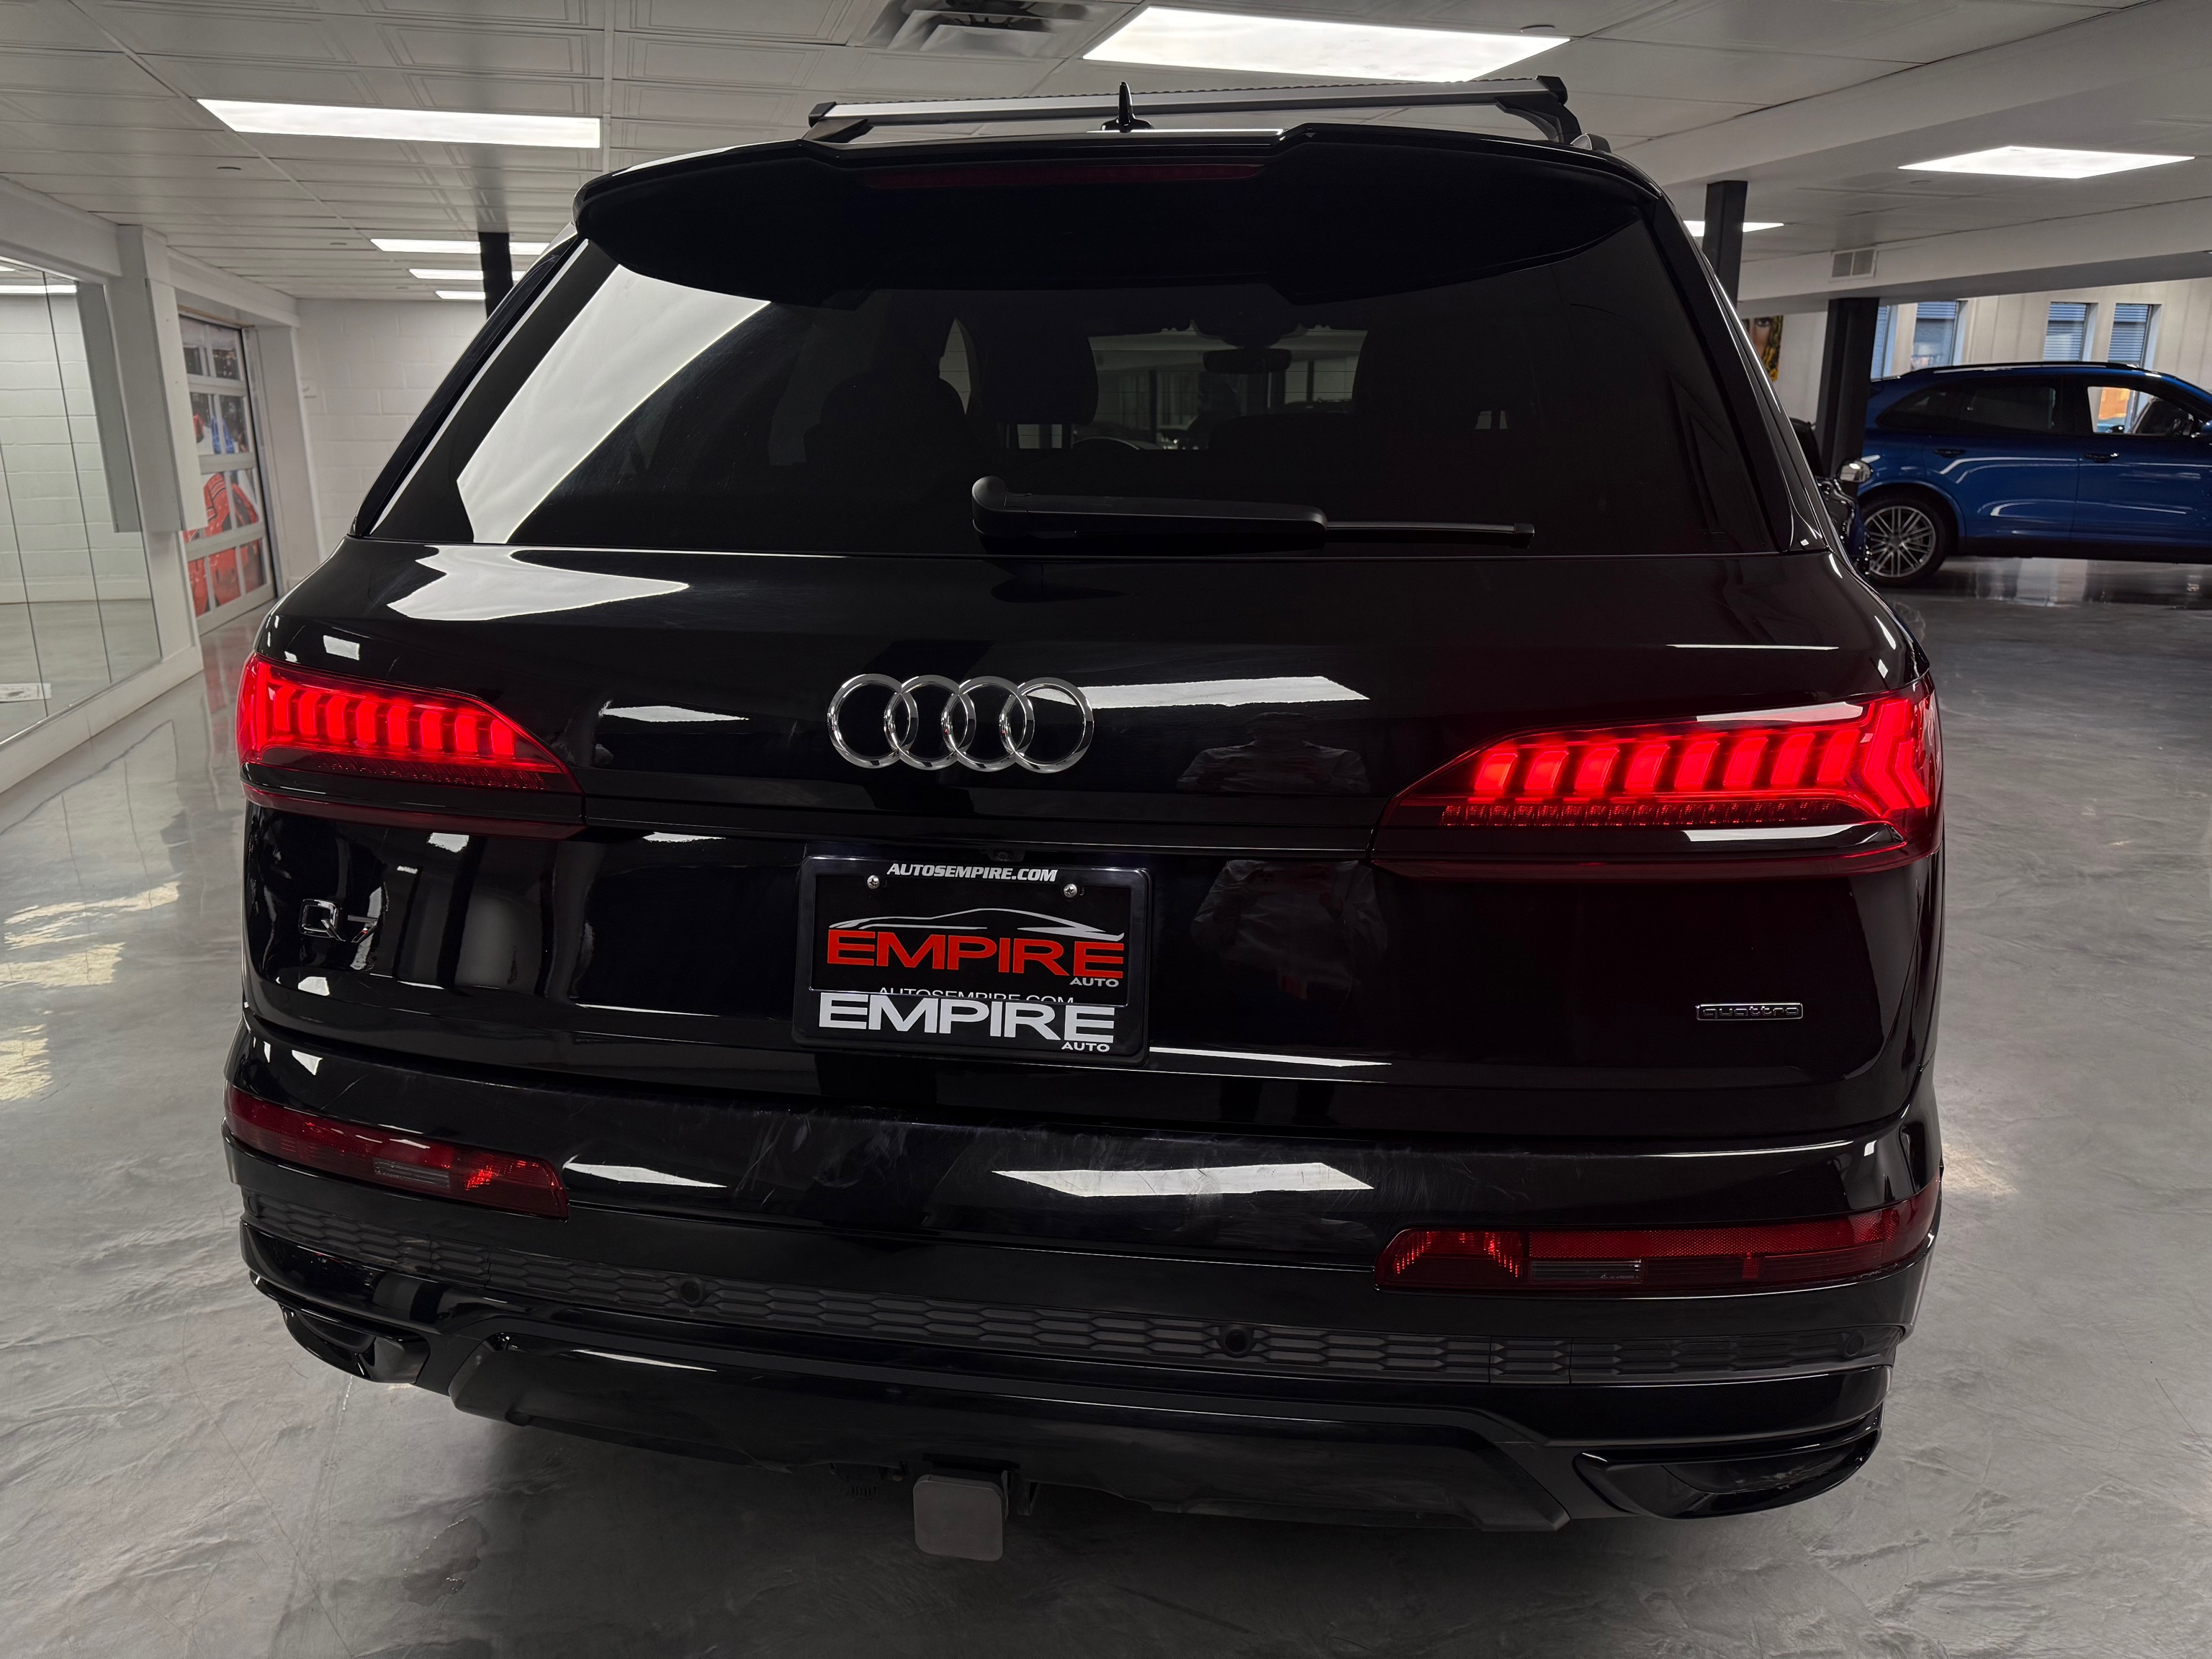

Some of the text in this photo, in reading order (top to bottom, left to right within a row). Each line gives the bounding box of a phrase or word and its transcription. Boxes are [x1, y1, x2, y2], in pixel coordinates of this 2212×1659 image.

[886, 863, 1058, 882] AUTOSEMPIRE.COM
[298, 899, 379, 943] Q7
[827, 929, 1124, 979] EMPIRE
[1069, 976, 1120, 987] AUTO
[819, 992, 1115, 1043] EMPIRE
[1702, 1006, 1799, 1018] quattro
[1061, 1042, 1110, 1053] AUTO
